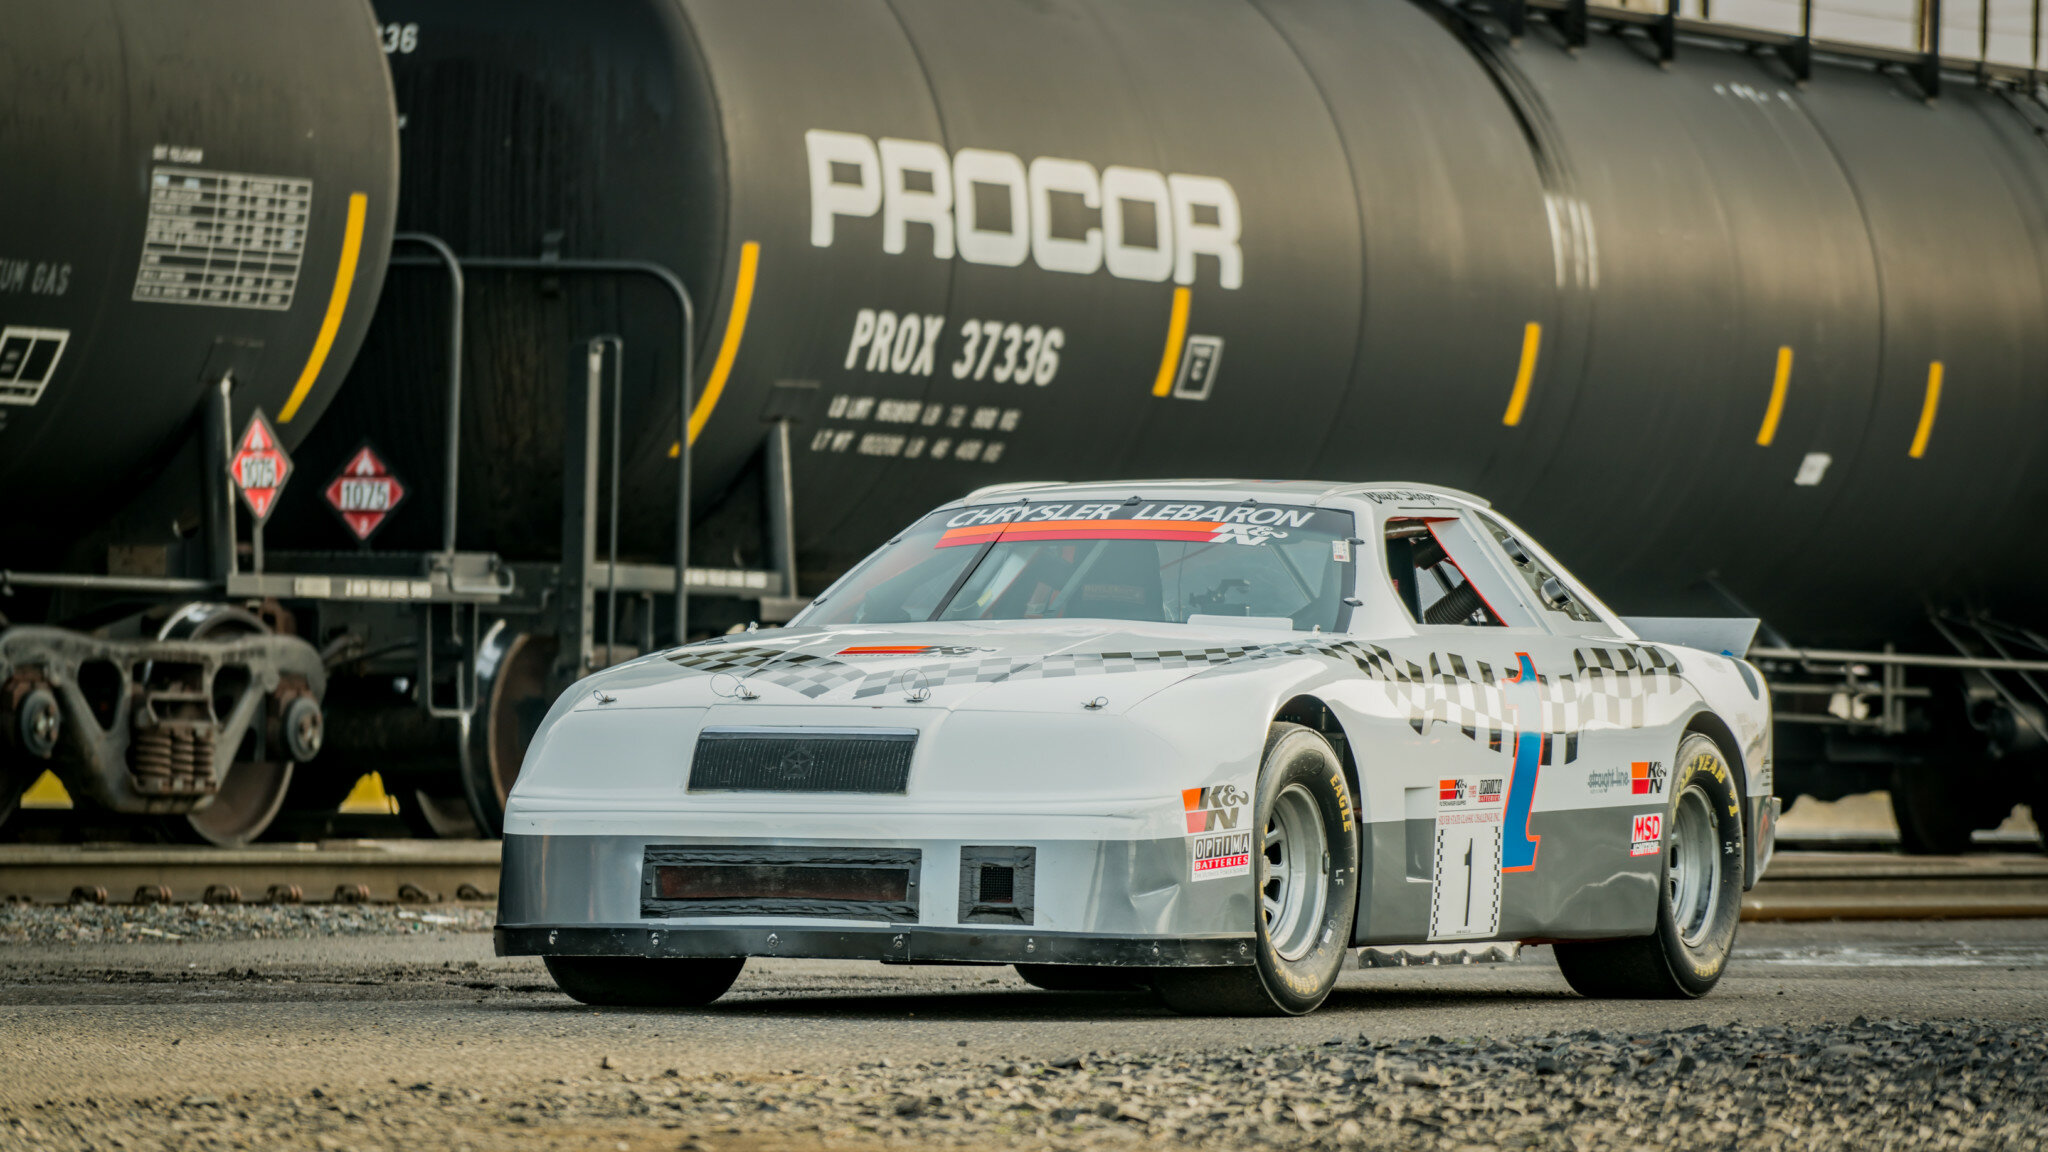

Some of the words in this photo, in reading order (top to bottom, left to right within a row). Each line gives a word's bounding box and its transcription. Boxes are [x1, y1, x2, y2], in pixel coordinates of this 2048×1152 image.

[805, 128, 1243, 290] PROCOR
[31, 261, 72, 296] GAS
[844, 308, 945, 377] PROX
[952, 318, 1065, 386] 37336
[342, 482, 389, 511] 1075
[946, 503, 1121, 528] CHRYSLER
[1131, 504, 1315, 528] LEBARON
[1208, 522, 1289, 546] K&N
[1501, 652, 1541, 873] 1
[1648, 762, 1667, 793] K&N
[1329, 773, 1354, 833] EAGLE
[1454, 778, 1467, 800] K&N
[1199, 784, 1250, 832] K&N
[1633, 815, 1661, 842] MSD
[1195, 833, 1250, 860] OPTIMA
[1194, 855, 1249, 871] BATTERIES
[1334, 868, 1345, 887] LF
[1464, 837, 1473, 927] 1
